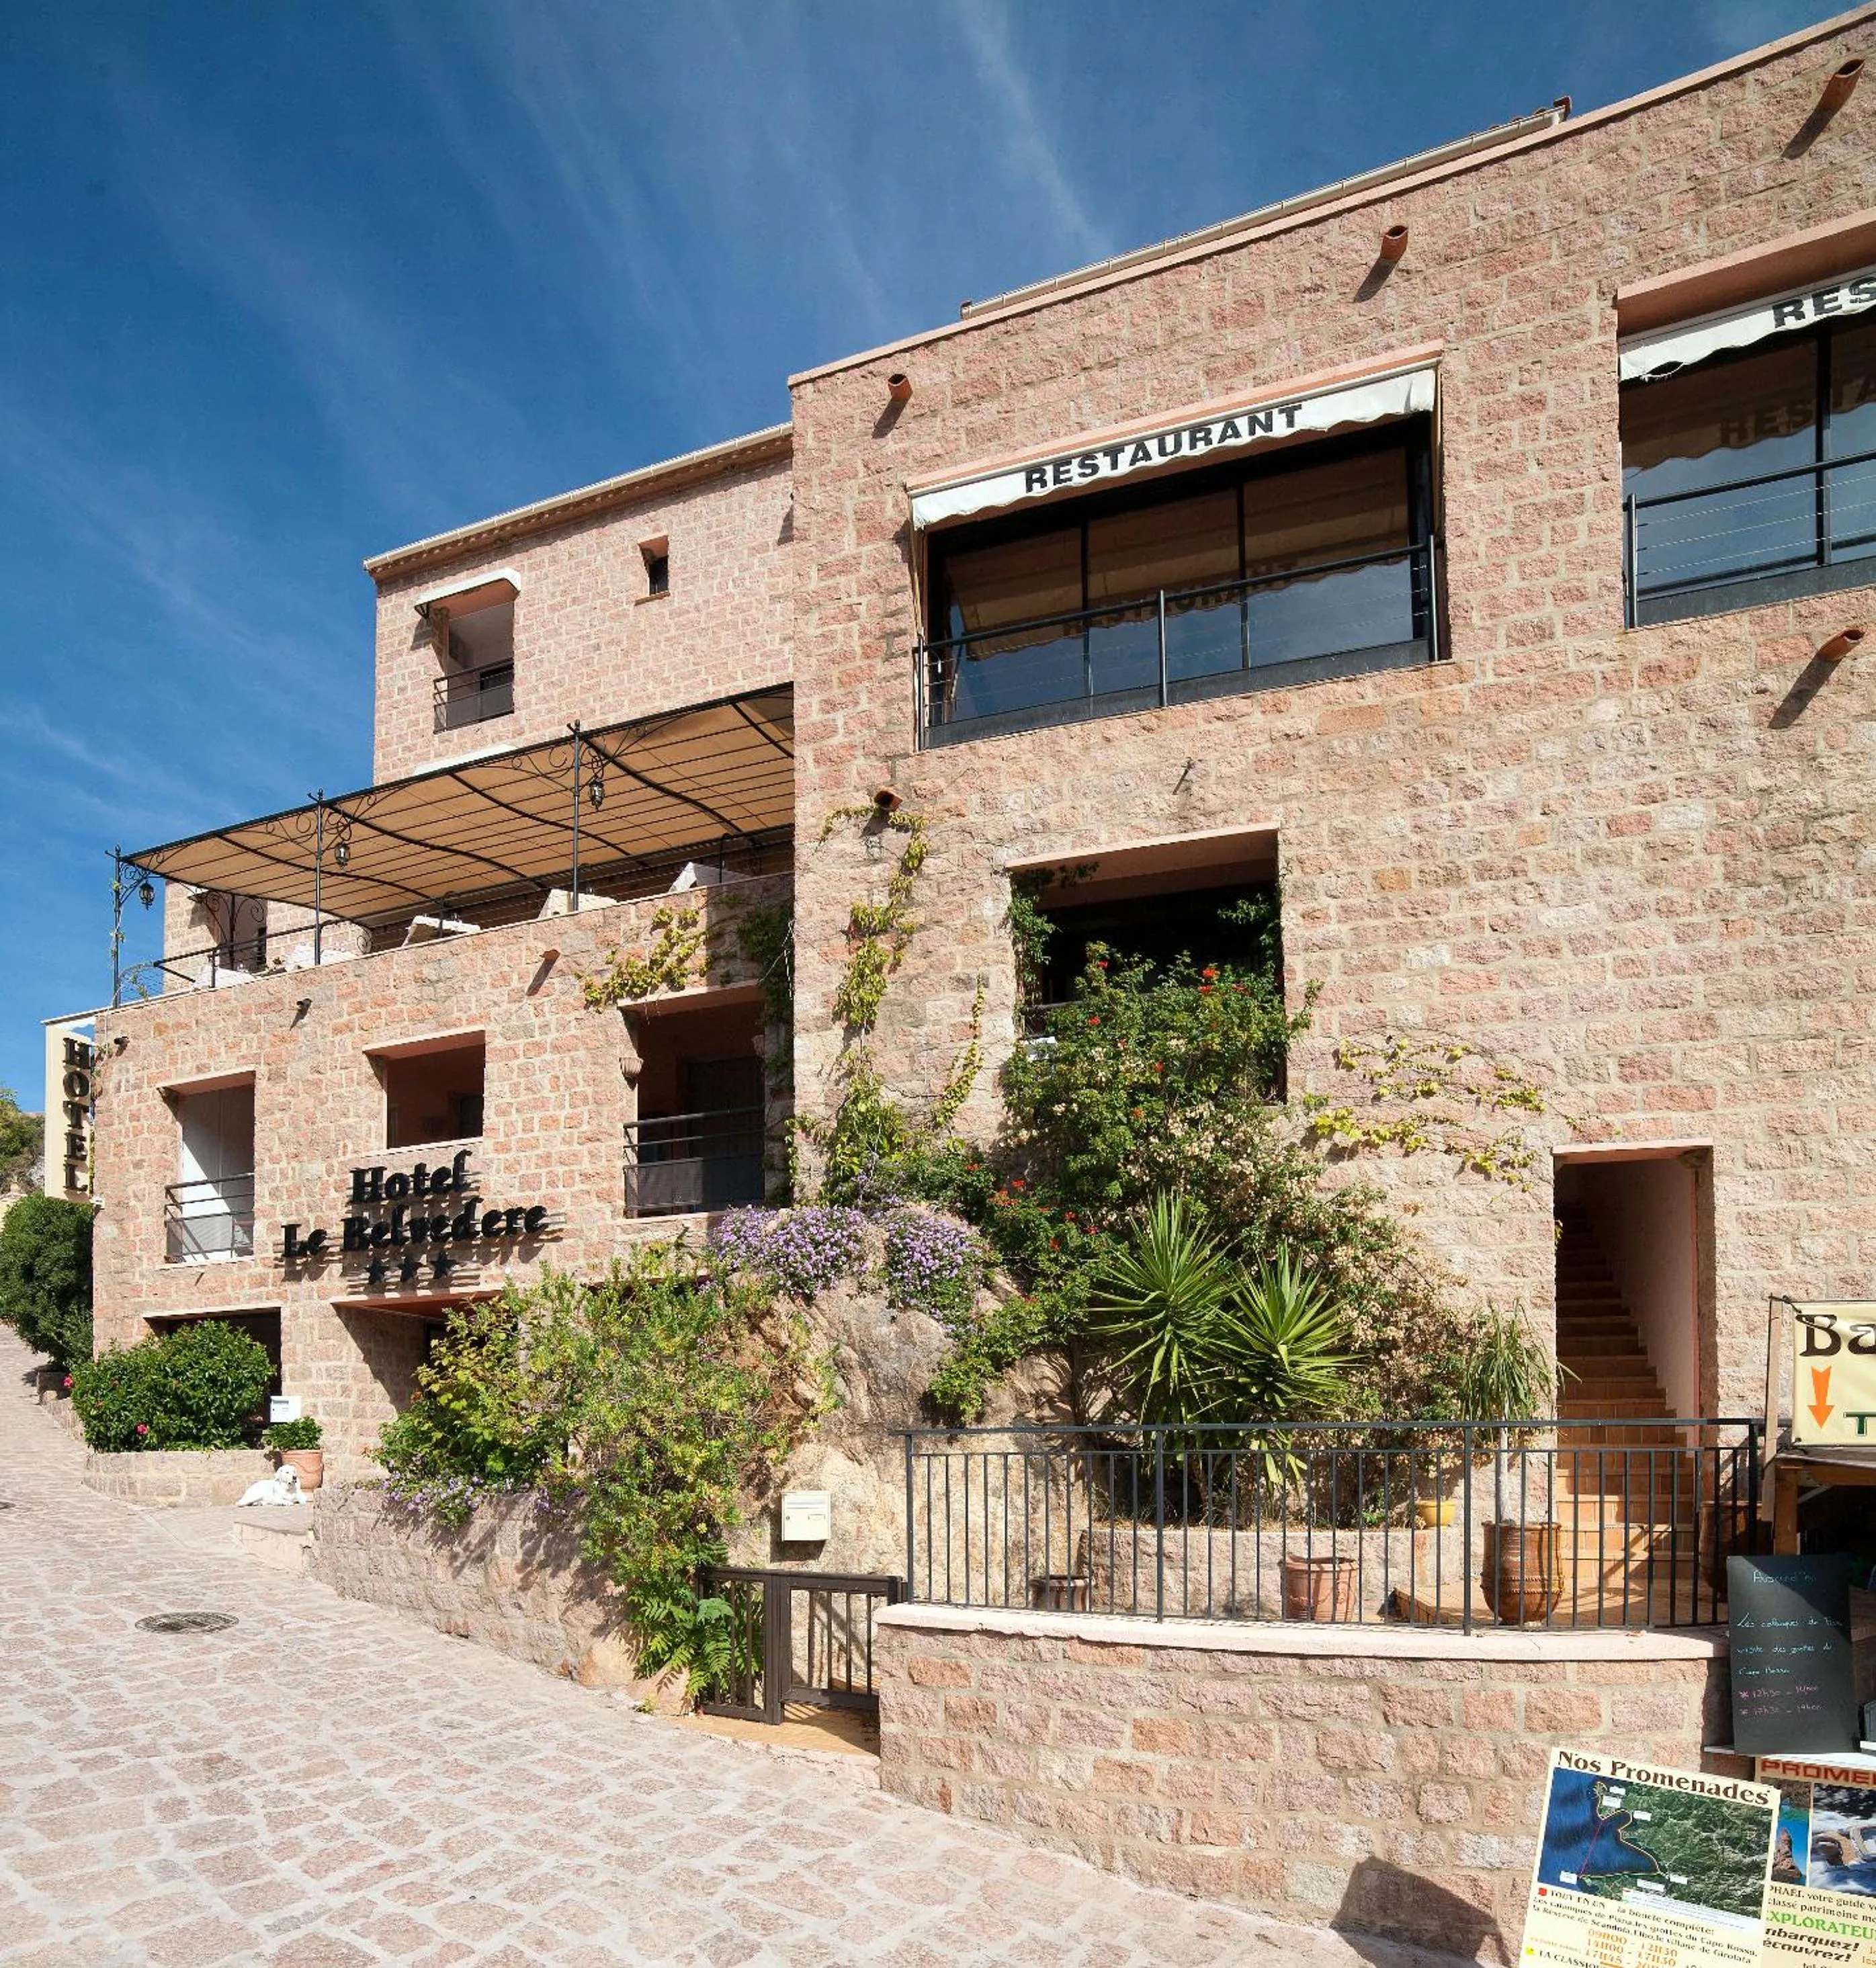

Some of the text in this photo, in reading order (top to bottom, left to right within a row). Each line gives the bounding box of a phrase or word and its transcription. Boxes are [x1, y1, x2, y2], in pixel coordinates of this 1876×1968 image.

[1025, 403, 1304, 495] RESTAURANT
[62, 1037, 91, 1192] HOTEL
[349, 1148, 473, 1203] Hotel
[280, 1195, 548, 1258] Le Belvedere
[1558, 1750, 1772, 1805] Nos Promenades
[1761, 1759, 1876, 1789] PROME
[1766, 1910, 1876, 1940] XPLORATEU
[1800, 1903, 1859, 1921] patrimoine
[1807, 1892, 1834, 1903] votre
[1836, 1898, 1865, 1911] guide
